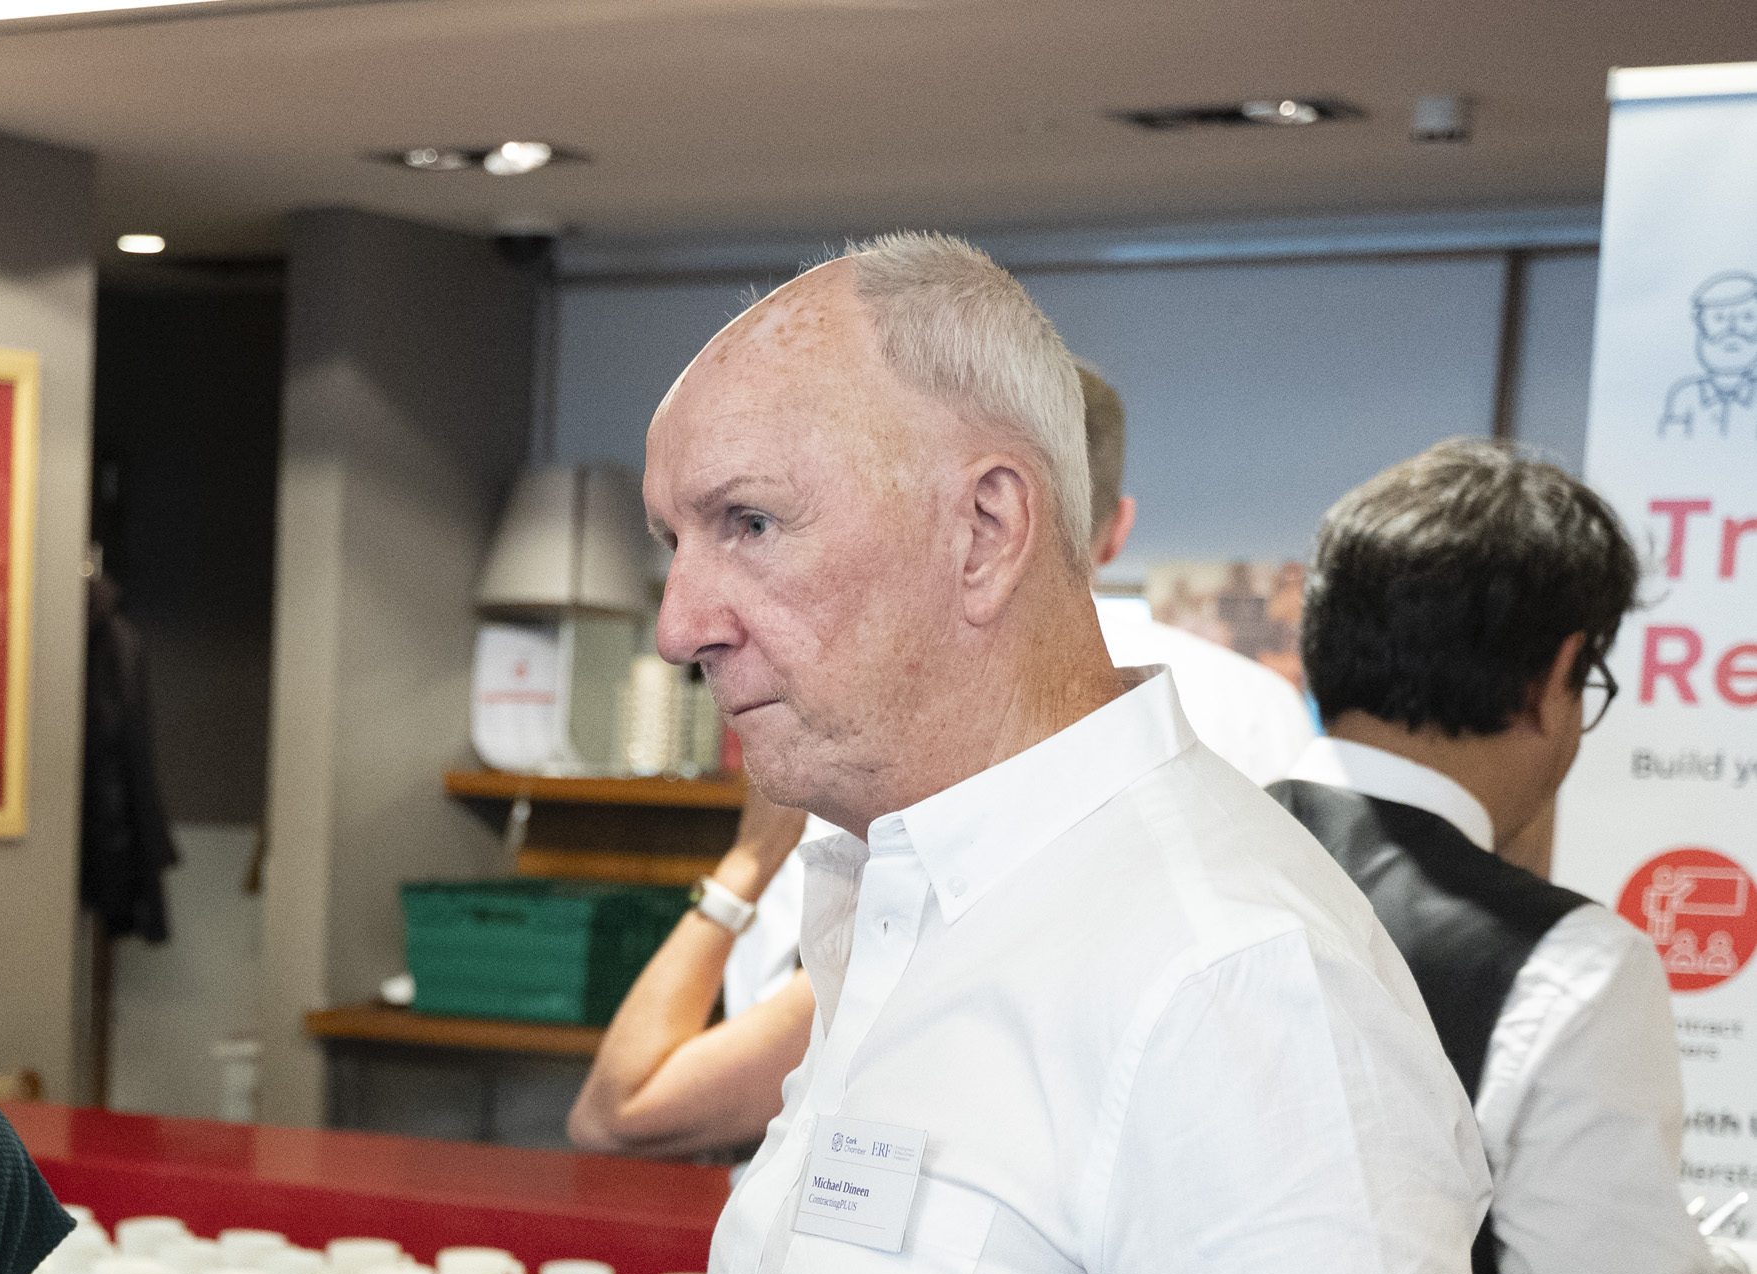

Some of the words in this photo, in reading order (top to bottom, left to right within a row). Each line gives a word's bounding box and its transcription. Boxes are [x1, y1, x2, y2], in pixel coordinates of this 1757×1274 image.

[1647, 497, 1757, 581] Tr
[1638, 624, 1757, 708] Re
[845, 1136, 857, 1145] Cork
[871, 1141, 893, 1158] ERF
[812, 1175, 843, 1192] Michael
[842, 1181, 870, 1197] Dineen
[808, 1193, 858, 1212] ContractingPLUS
